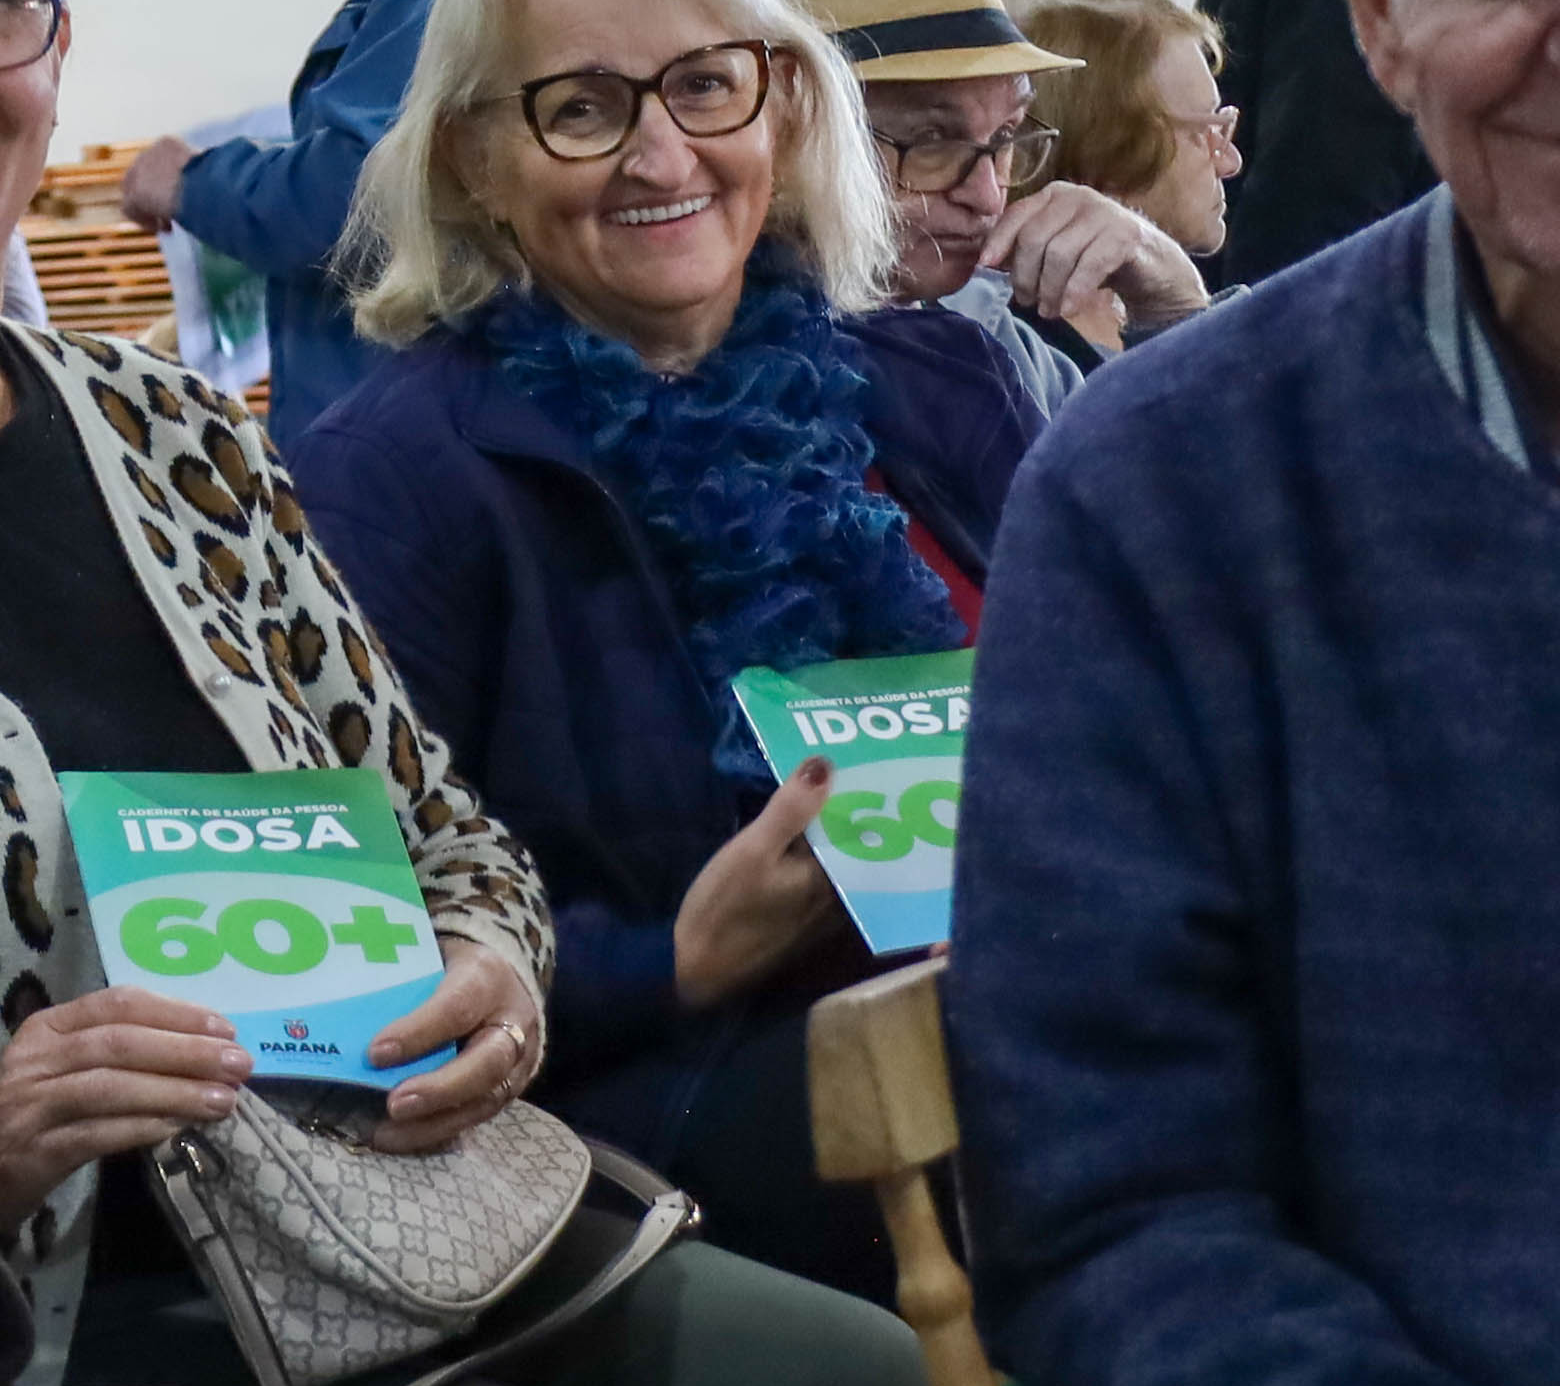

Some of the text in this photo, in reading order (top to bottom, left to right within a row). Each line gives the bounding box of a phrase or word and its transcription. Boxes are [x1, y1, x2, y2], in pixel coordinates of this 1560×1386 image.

[786, 696, 852, 709] CADERNETA
[854, 696, 869, 705] DE
[909, 691, 927, 700] DA
[118, 803, 349, 818] CADERNETA DE SAÚDE DA PESSOA
[123, 815, 360, 852] IDOSA
[120, 897, 418, 976] 60+
